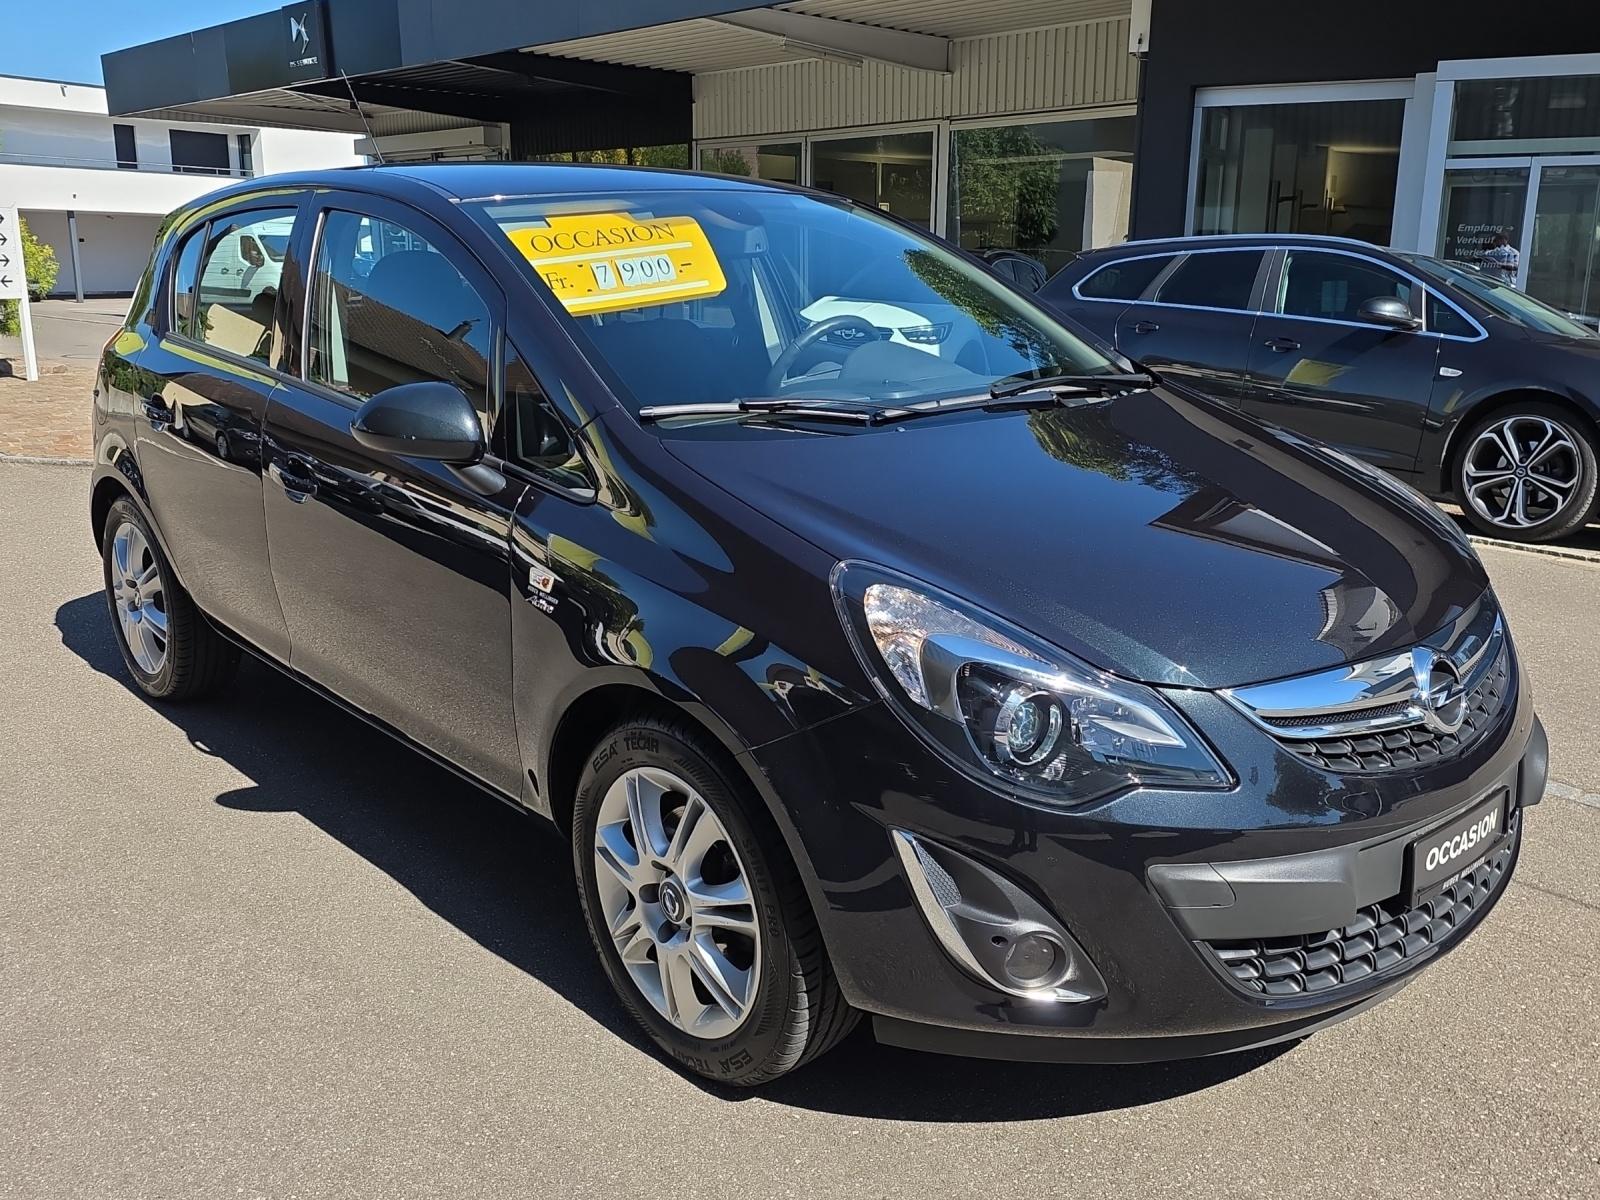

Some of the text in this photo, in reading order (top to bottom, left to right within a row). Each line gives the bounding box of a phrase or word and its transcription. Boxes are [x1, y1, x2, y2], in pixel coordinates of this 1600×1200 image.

[1457, 223, 1503, 233] Empfang
[530, 223, 675, 254] OCCASION
[1457, 236, 1495, 244] Verkauf
[544, 272, 574, 290] Fr.
[1425, 807, 1498, 871] OCCASION
